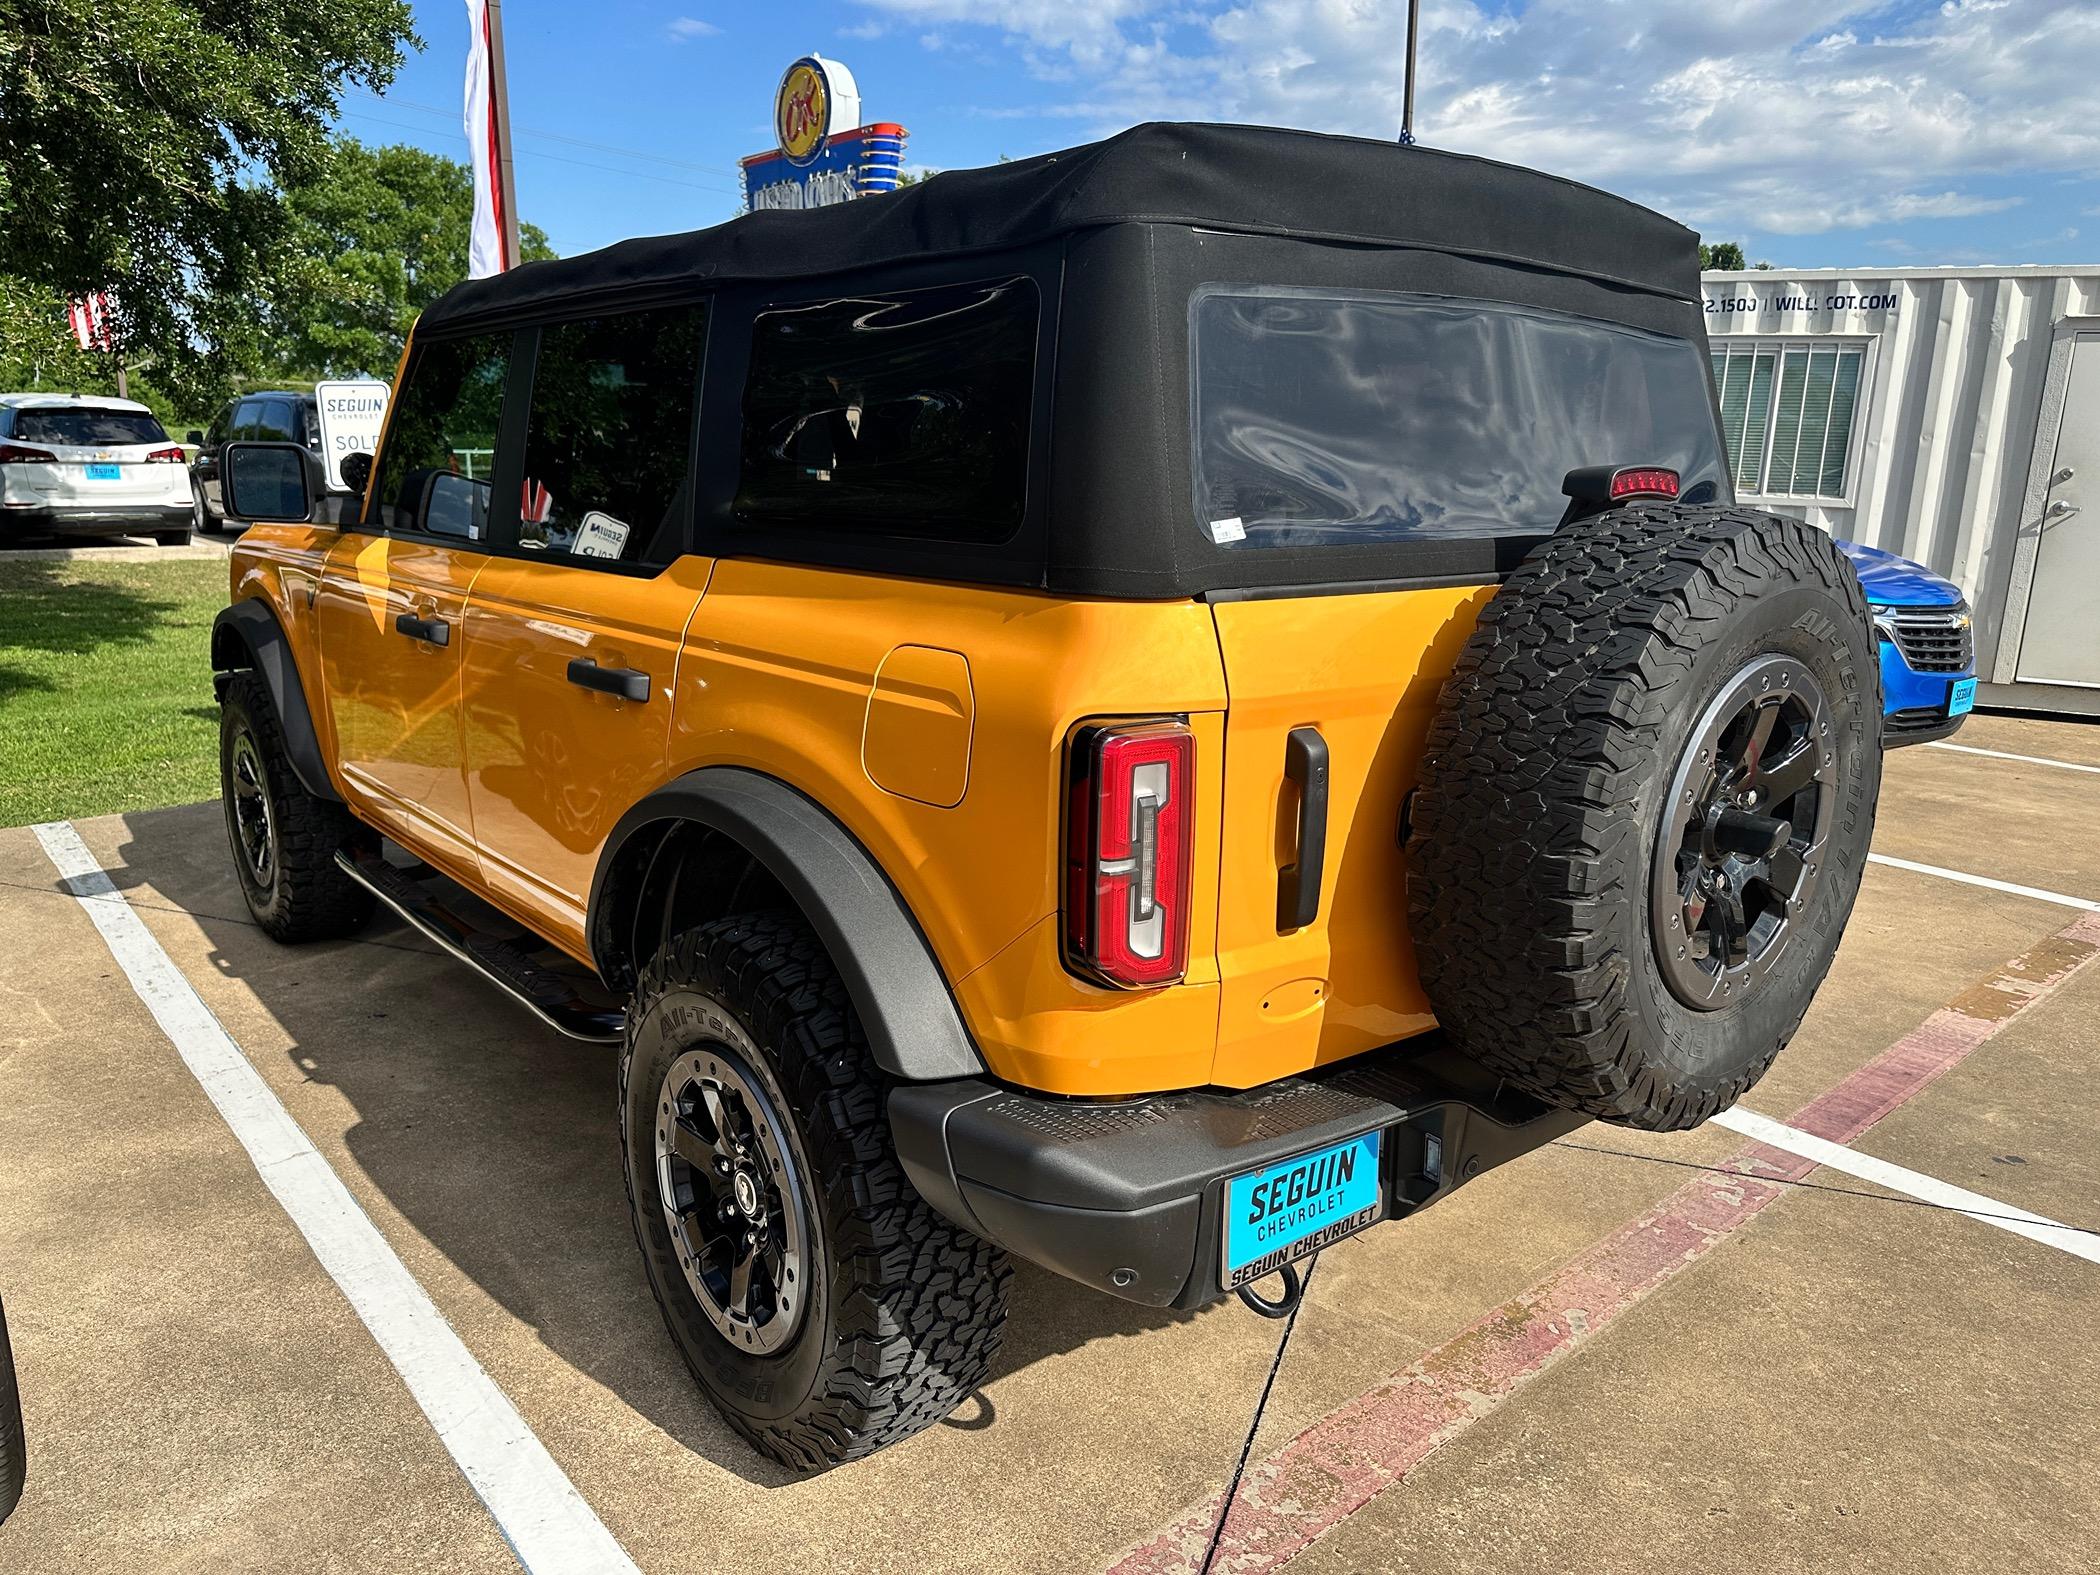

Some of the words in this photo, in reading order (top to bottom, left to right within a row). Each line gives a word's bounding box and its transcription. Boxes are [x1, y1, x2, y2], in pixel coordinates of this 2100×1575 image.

[785, 73, 820, 143] OK
[327, 399, 383, 412] SEGUIN
[1789, 607, 1864, 834] All-Terrain
[1249, 1146, 1358, 1225] SEGUIN
[1257, 1190, 1346, 1242] CHEVROLET
[1231, 1246, 1290, 1288] SEGUIN
[1293, 1205, 1379, 1257] CHEVROLET
